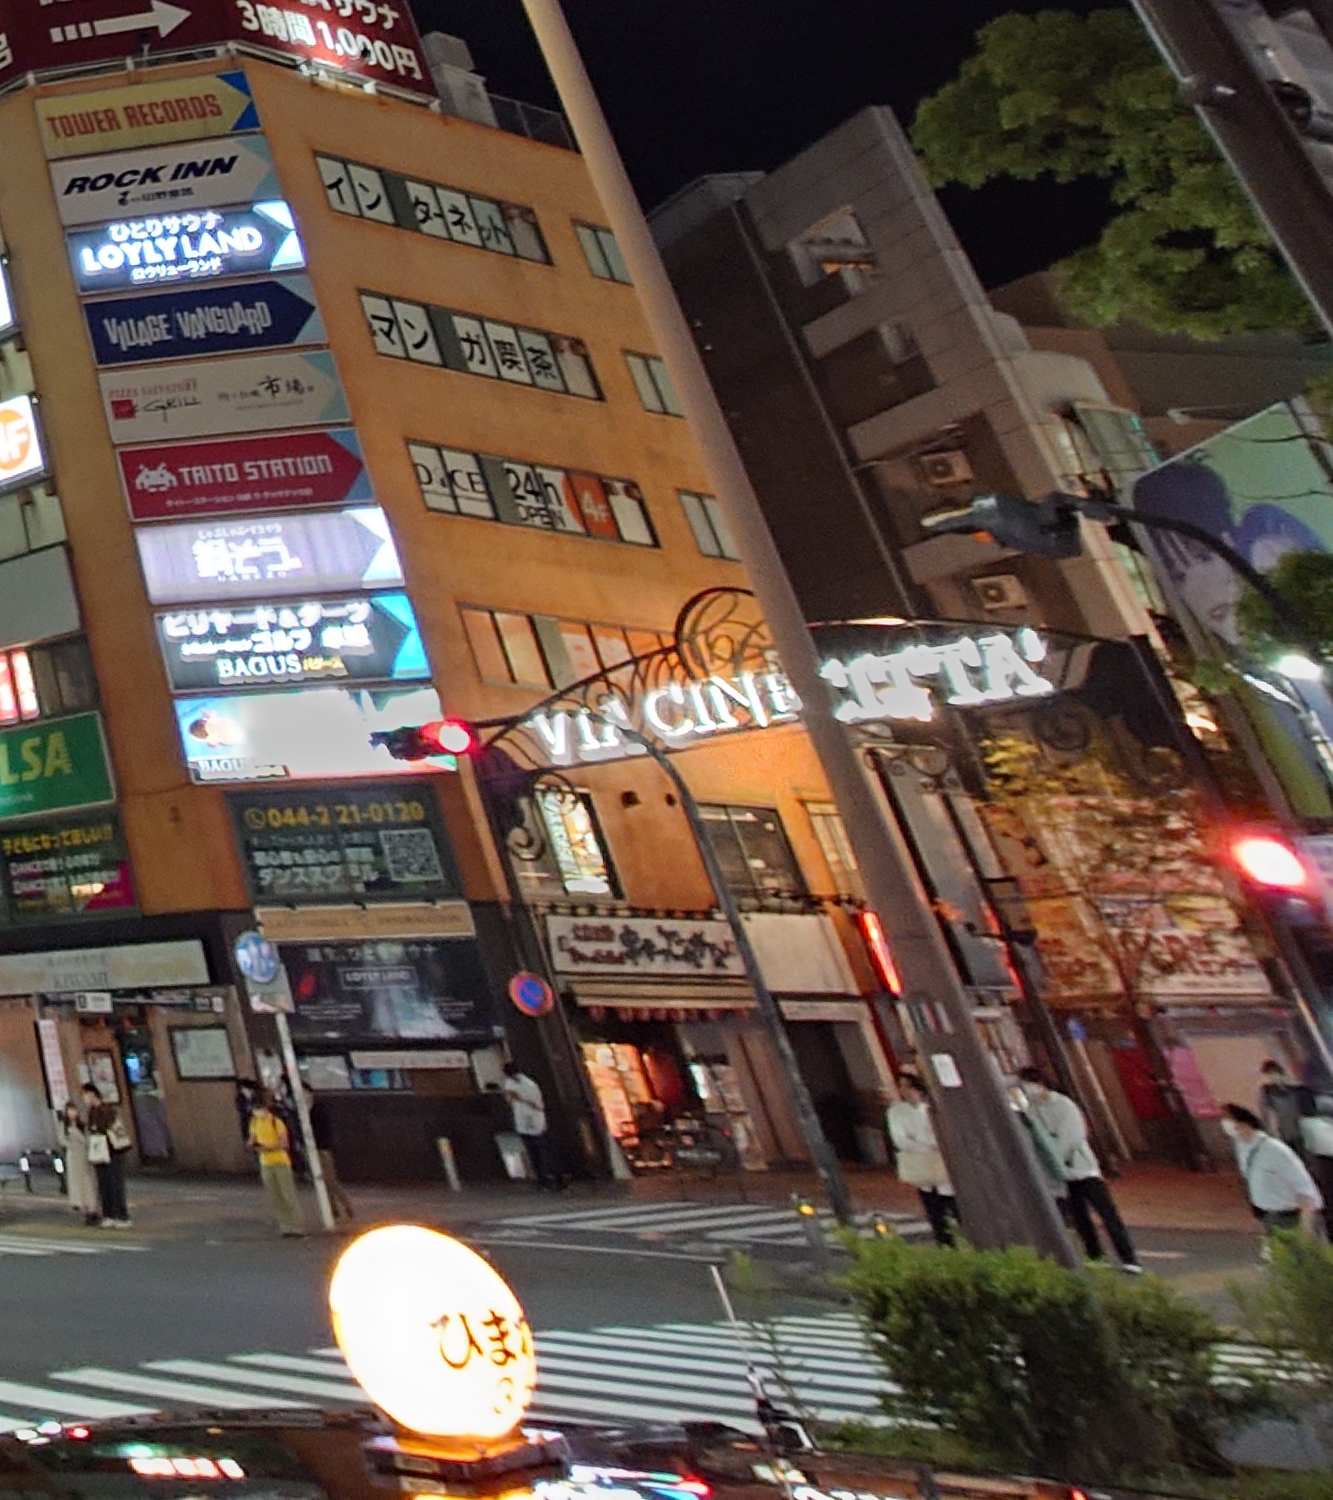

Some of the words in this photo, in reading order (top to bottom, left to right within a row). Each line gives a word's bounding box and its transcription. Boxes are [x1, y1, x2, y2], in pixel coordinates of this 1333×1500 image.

[237, 0, 316, 46] 3時間
[47, 108, 121, 139] TOWER
[123, 94, 223, 128] RECORDS
[63, 164, 167, 195] ROCK
[170, 155, 238, 182] INN
[109, 212, 224, 243] ひとりサウナ
[326, 177, 510, 249] インターネット
[80, 235, 180, 275] LOYLY
[180, 226, 263, 257] LAND
[103, 314, 172, 351] VILLAGE
[176, 301, 273, 340] VANGUARD
[179, 464, 240, 487] TAITO
[244, 455, 333, 480] STATION
[217, 655, 302, 678] BAGUS
